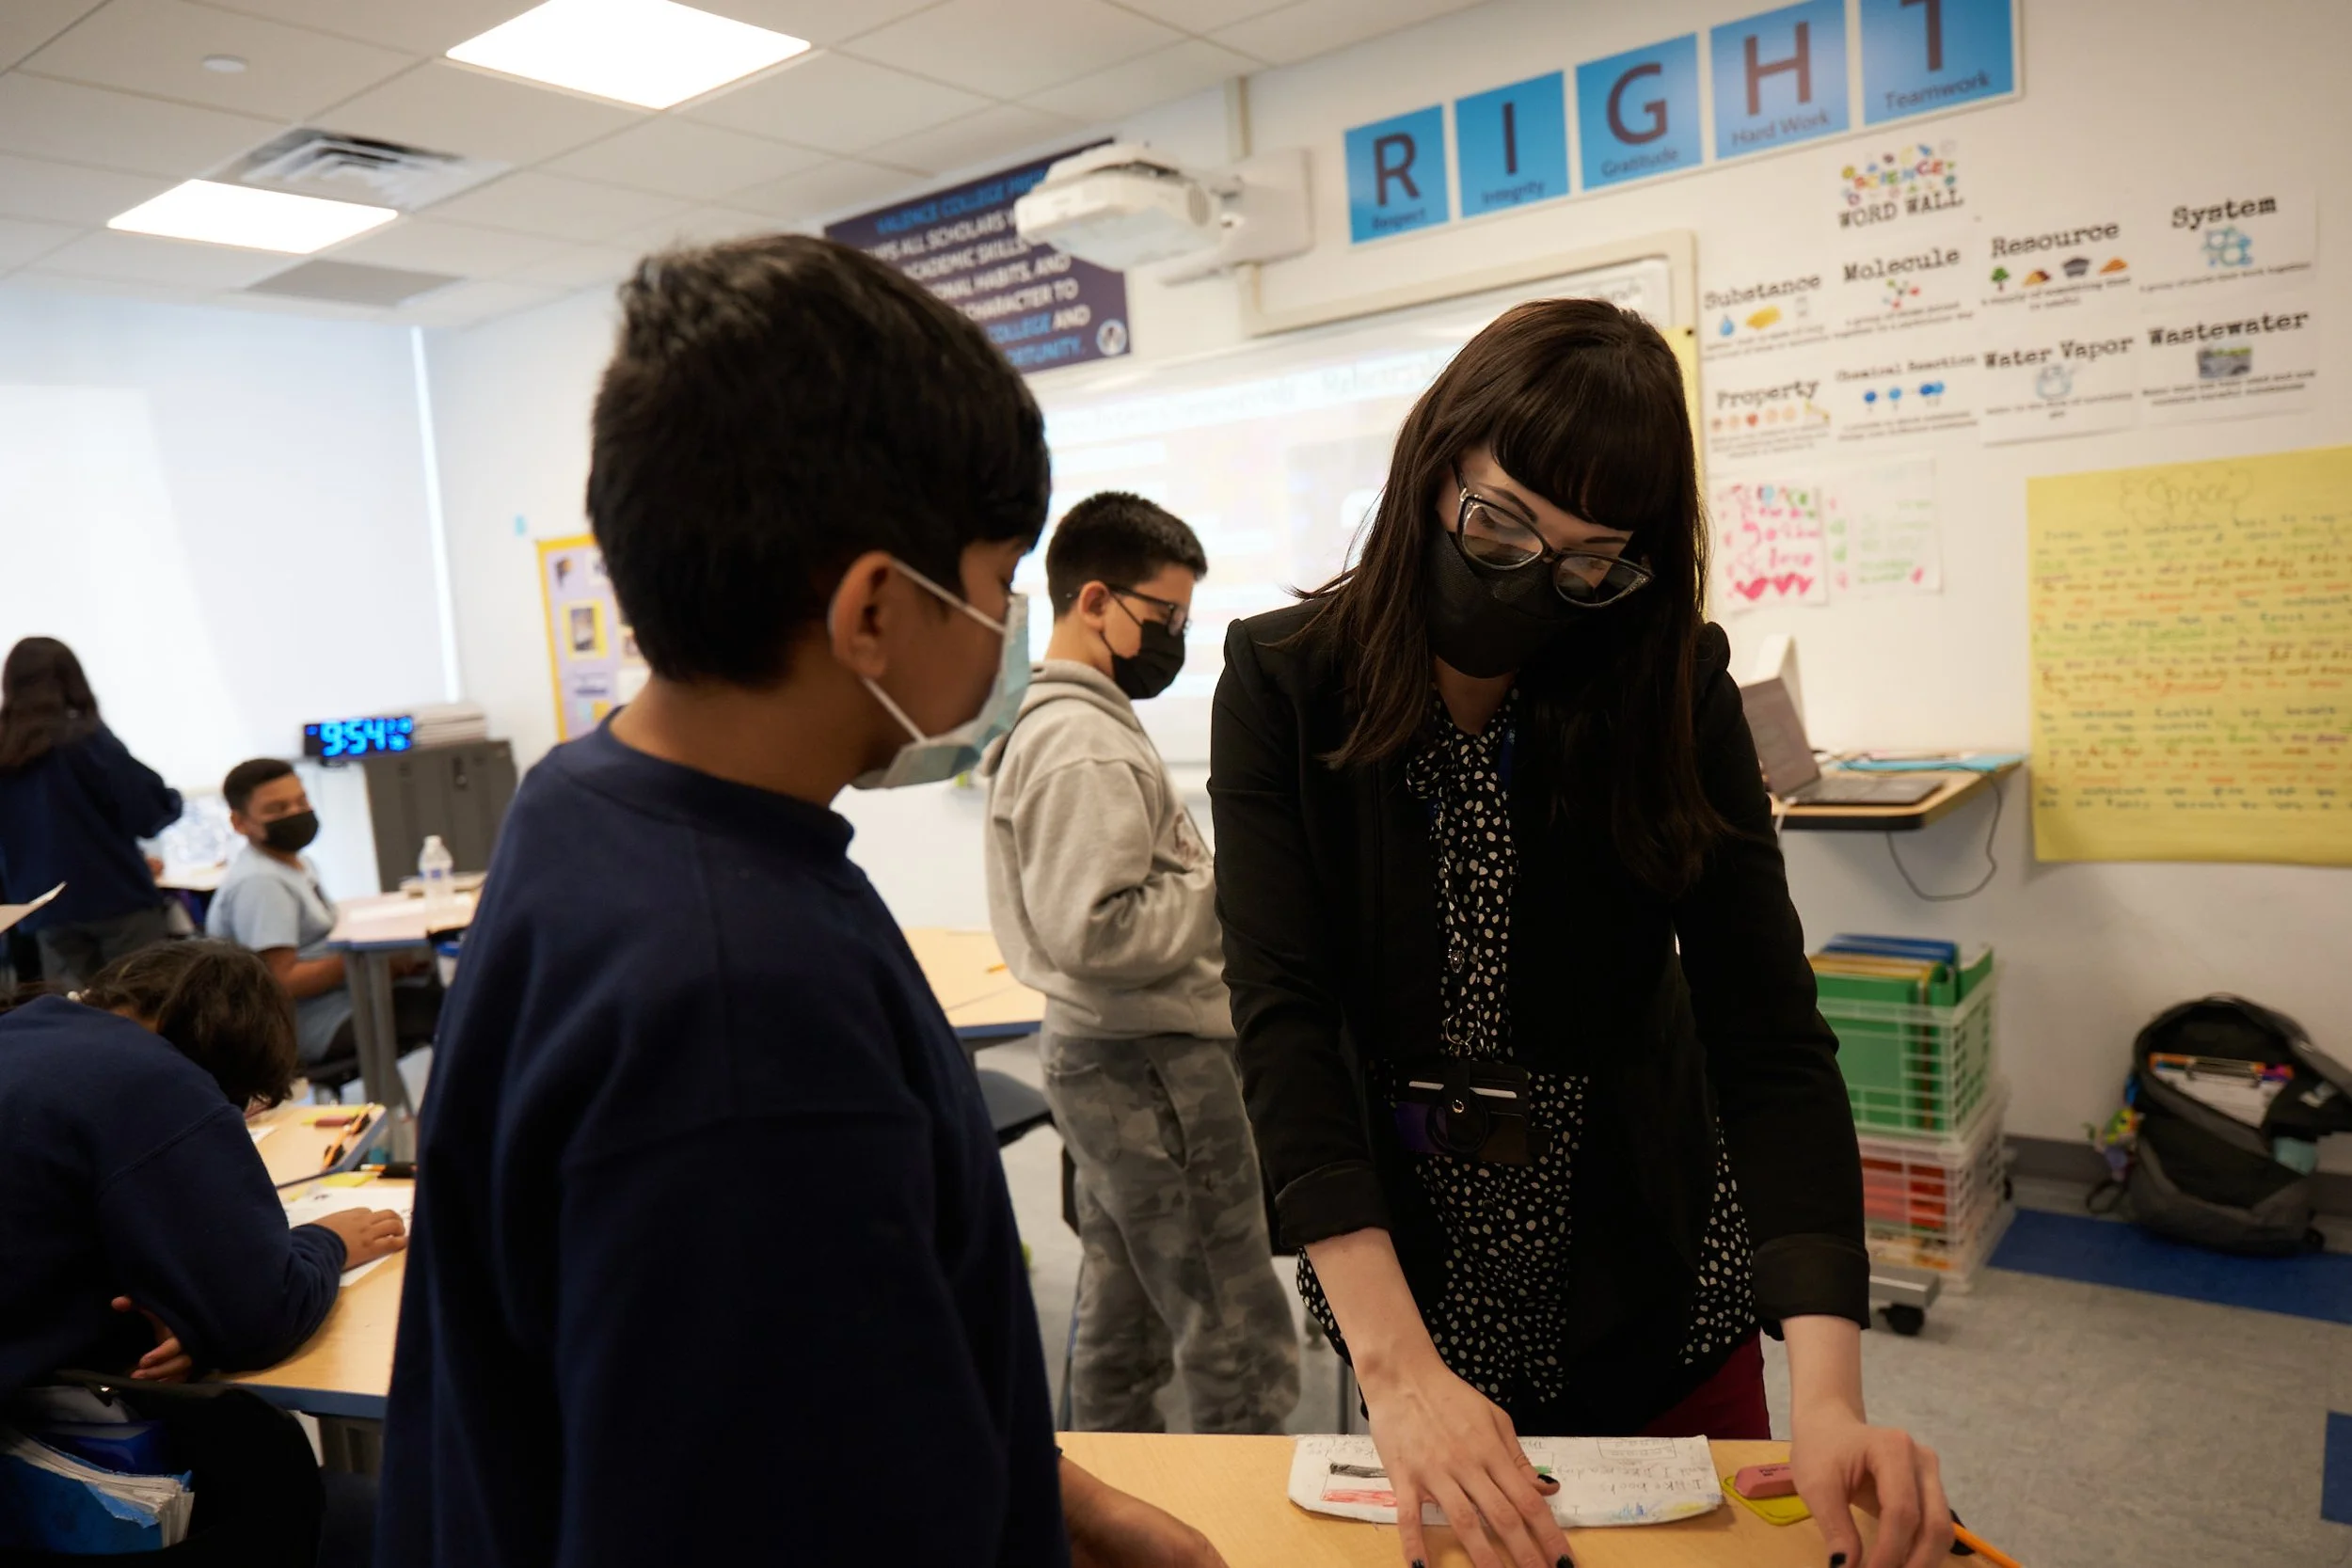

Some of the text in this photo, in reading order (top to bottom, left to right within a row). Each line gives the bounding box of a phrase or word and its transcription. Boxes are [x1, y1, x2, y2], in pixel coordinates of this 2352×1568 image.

[1884, 69, 1991, 110] Teamwork
[1732, 108, 1830, 147] Hard Work
[1601, 147, 1678, 179] Gratitude
[1482, 180, 1545, 206] Integrity
[1837, 188, 1965, 229] WORD WALL
[2171, 195, 2278, 230] System
[926, 210, 1007, 251] SCHOLARS
[1991, 222, 2121, 260] Resource
[1035, 252, 1073, 277] AND
[1843, 247, 1961, 283] Molecule
[1053, 277, 1080, 302] TO
[1703, 274, 1821, 310] Substance
[1052, 303, 1092, 330] AND
[2148, 311, 2311, 348] Wastewater
[1984, 336, 2134, 371] Water Vapor
[1717, 380, 1820, 410] Property
